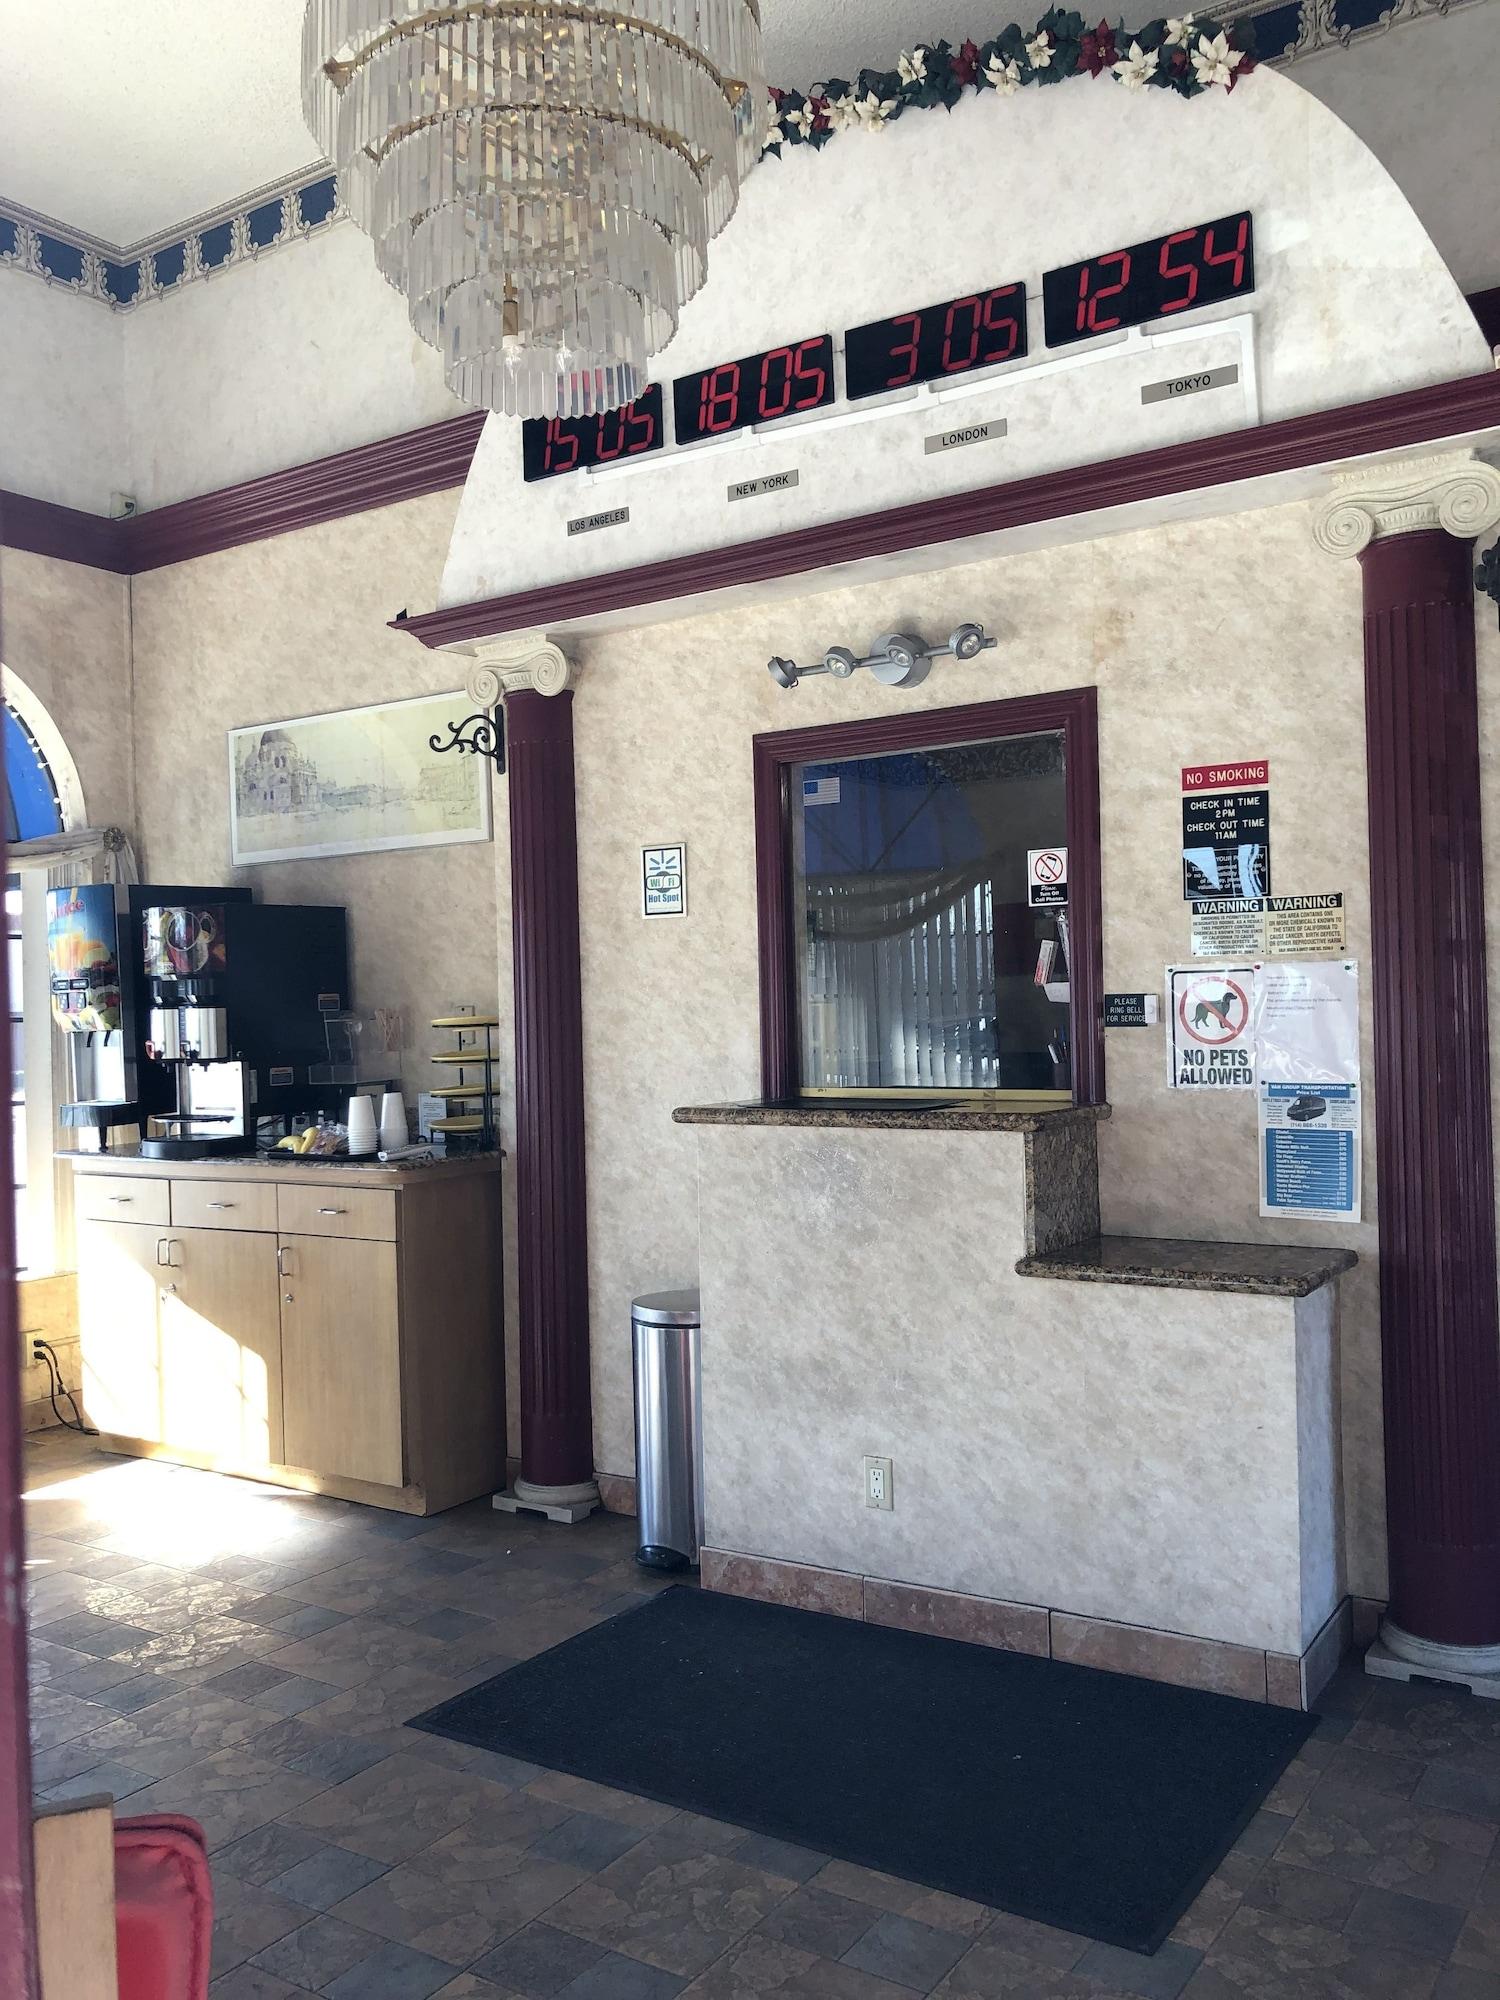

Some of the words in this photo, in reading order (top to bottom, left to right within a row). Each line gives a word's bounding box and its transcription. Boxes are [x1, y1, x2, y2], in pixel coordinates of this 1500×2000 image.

[1166, 374, 1211, 394] TOKYO
[942, 426, 988, 446] LONDON
[736, 482, 757, 496] NEW
[762, 474, 789, 490] YORK
[569, 521, 586, 532] LOS
[589, 510, 626, 527] ANGELES
[1186, 772, 1203, 785] NO
[1208, 766, 1265, 783] SMOKING
[1190, 800, 1220, 810] CHECK
[1224, 799, 1234, 807] IN
[1237, 796, 1260, 806] TIME
[1215, 810, 1221, 818] 2
[1222, 809, 1235, 817] PM
[1186, 822, 1216, 832] CHECK
[1219, 820, 1238, 830] OUT
[1242, 818, 1265, 828] TIME
[650, 878, 661, 887] Wi
[668, 877, 675, 886] Fi
[648, 894, 661, 903] Hot
[662, 893, 679, 903] Spot
[1272, 895, 1338, 911] WARNING
[1196, 899, 1259, 914] WARNING
[1114, 997, 1138, 1005] PLEASE
[1110, 1006, 1125, 1014] RING
[1126, 1006, 1142, 1014] BELL
[1106, 1014, 1119, 1022] FOR
[1183, 1049, 1205, 1066] NO
[1209, 1049, 1249, 1067] PETS
[1179, 1067, 1253, 1085] ALLOWED
